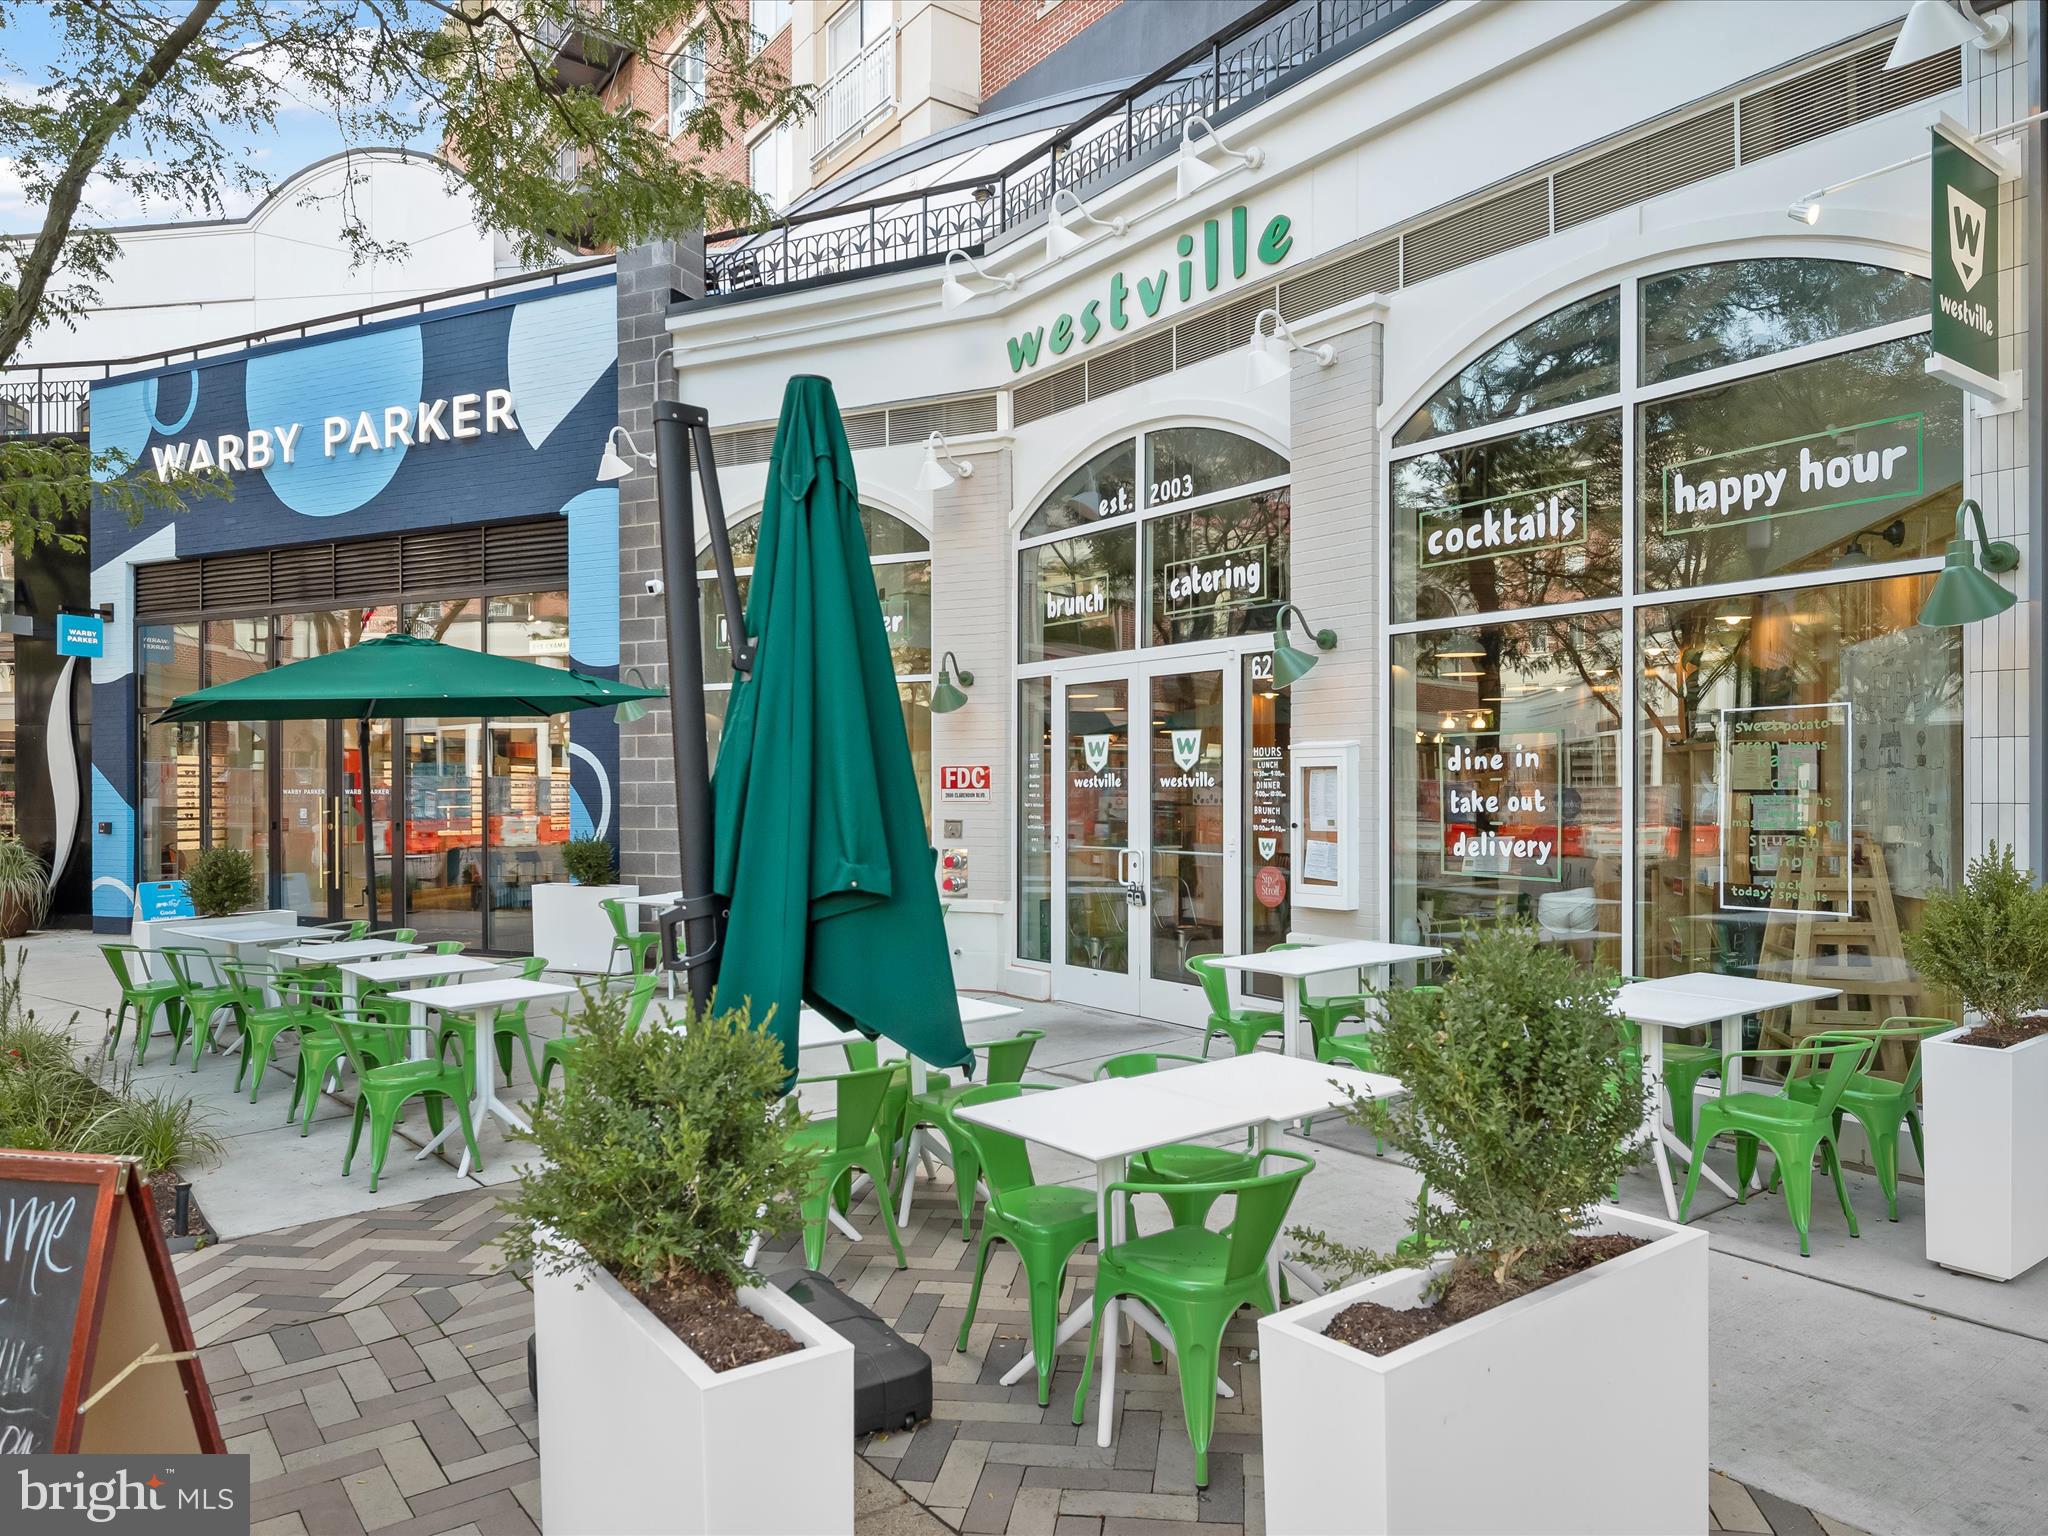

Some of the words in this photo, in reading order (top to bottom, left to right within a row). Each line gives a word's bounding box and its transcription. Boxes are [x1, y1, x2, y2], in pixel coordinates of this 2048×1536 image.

[1006, 205, 1294, 373] westville
[1939, 293, 1994, 337] westville
[152, 422, 303, 484] WARBY
[323, 388, 519, 459] PARKER
[1673, 467, 1787, 515] happy
[1799, 445, 1907, 493] hour
[1099, 487, 1133, 517] est.
[1150, 474, 1193, 504] 2003
[1427, 496, 1576, 556] cocktails
[1169, 559, 1261, 600] catering
[1046, 583, 1104, 619] brunch
[68, 628, 97, 637] WARBY
[883, 615, 903, 633] er
[67, 635, 98, 645] PARKER
[1782, 718, 1830, 735] potato
[1253, 746, 1282, 757] HOURS
[1738, 742, 1780, 753] green
[1257, 761, 1279, 769] LUNCH
[1447, 744, 1503, 772] dine
[1515, 743, 1539, 769] in
[945, 767, 986, 788] FDC
[1073, 772, 1122, 788] westville
[1159, 771, 1215, 788] westville
[1256, 781, 1281, 790] DINNER
[1253, 805, 1281, 815] BRUNCH
[1450, 789, 1499, 814] take
[1507, 788, 1546, 813] out
[1453, 830, 1552, 866] delivery
[1749, 834, 1820, 850] squash
[1730, 884, 1777, 900] today's
